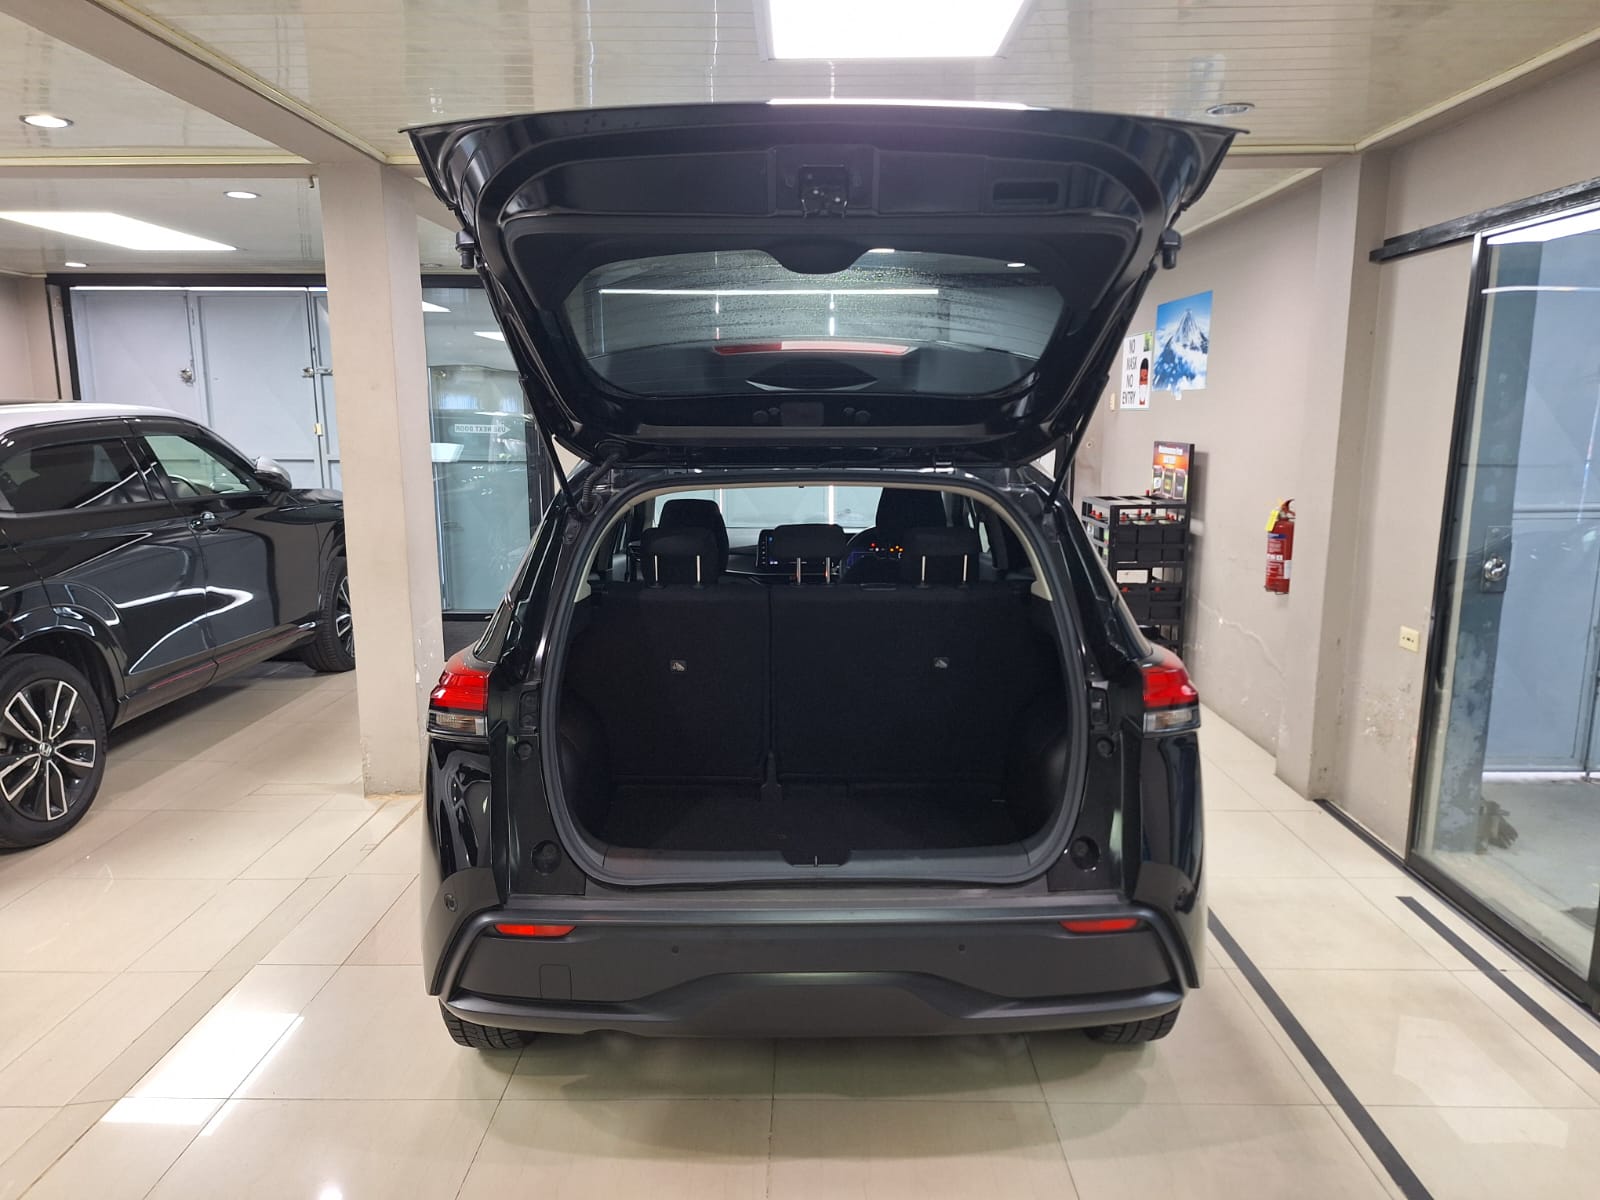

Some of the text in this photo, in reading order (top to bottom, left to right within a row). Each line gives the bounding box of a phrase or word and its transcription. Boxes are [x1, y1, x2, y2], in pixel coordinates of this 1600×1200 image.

[1128, 338, 1136, 354] NO
[1126, 356, 1138, 371] MASK
[1126, 373, 1134, 388] NO
[1122, 391, 1136, 405] ENTRY
